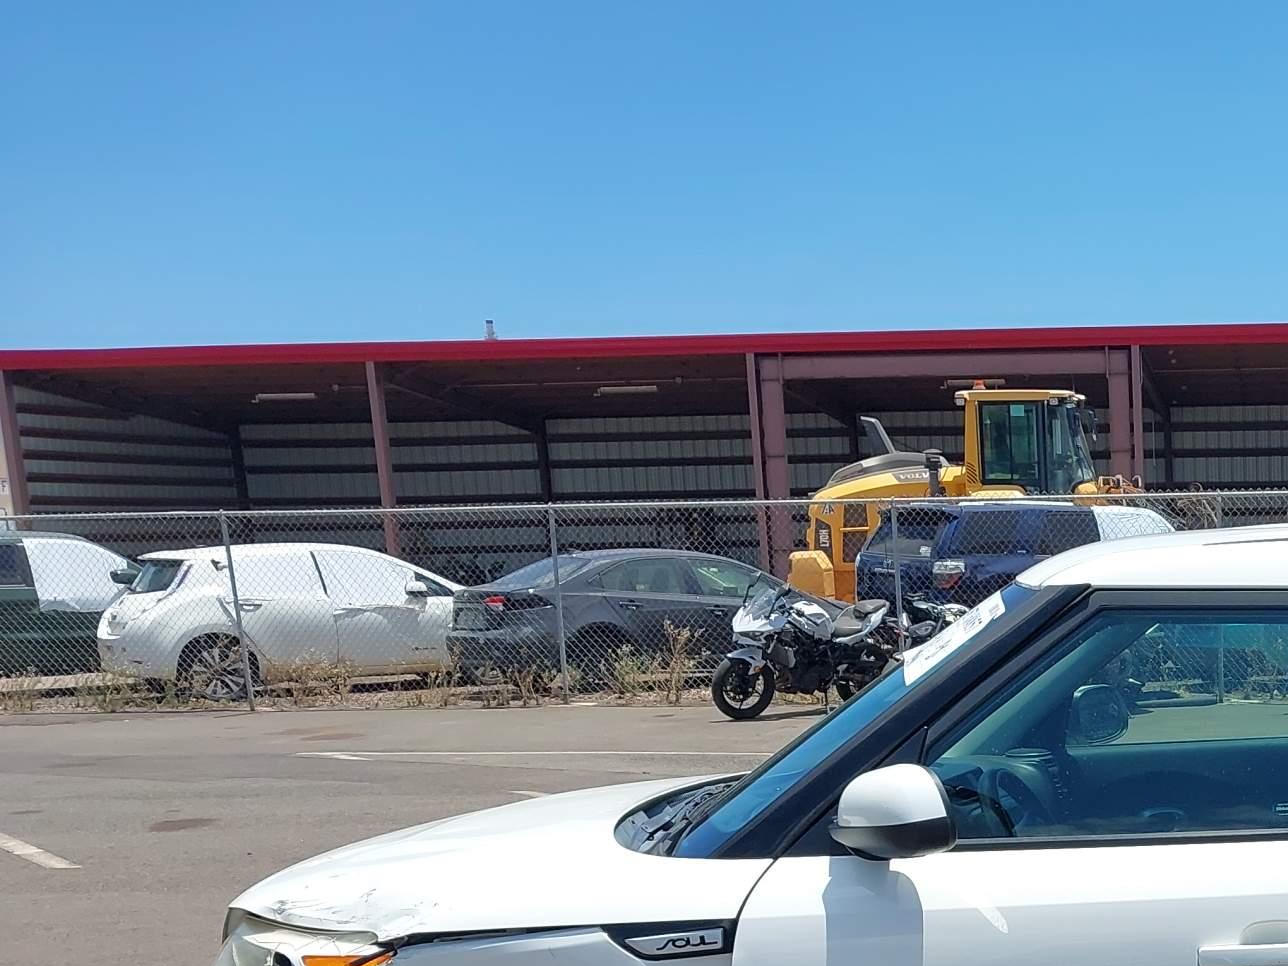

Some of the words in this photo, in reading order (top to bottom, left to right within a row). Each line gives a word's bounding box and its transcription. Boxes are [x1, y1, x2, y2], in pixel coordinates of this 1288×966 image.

[899, 471, 930, 480] VOLV
[819, 529, 830, 547] L70H
[656, 935, 718, 951] SOUL
